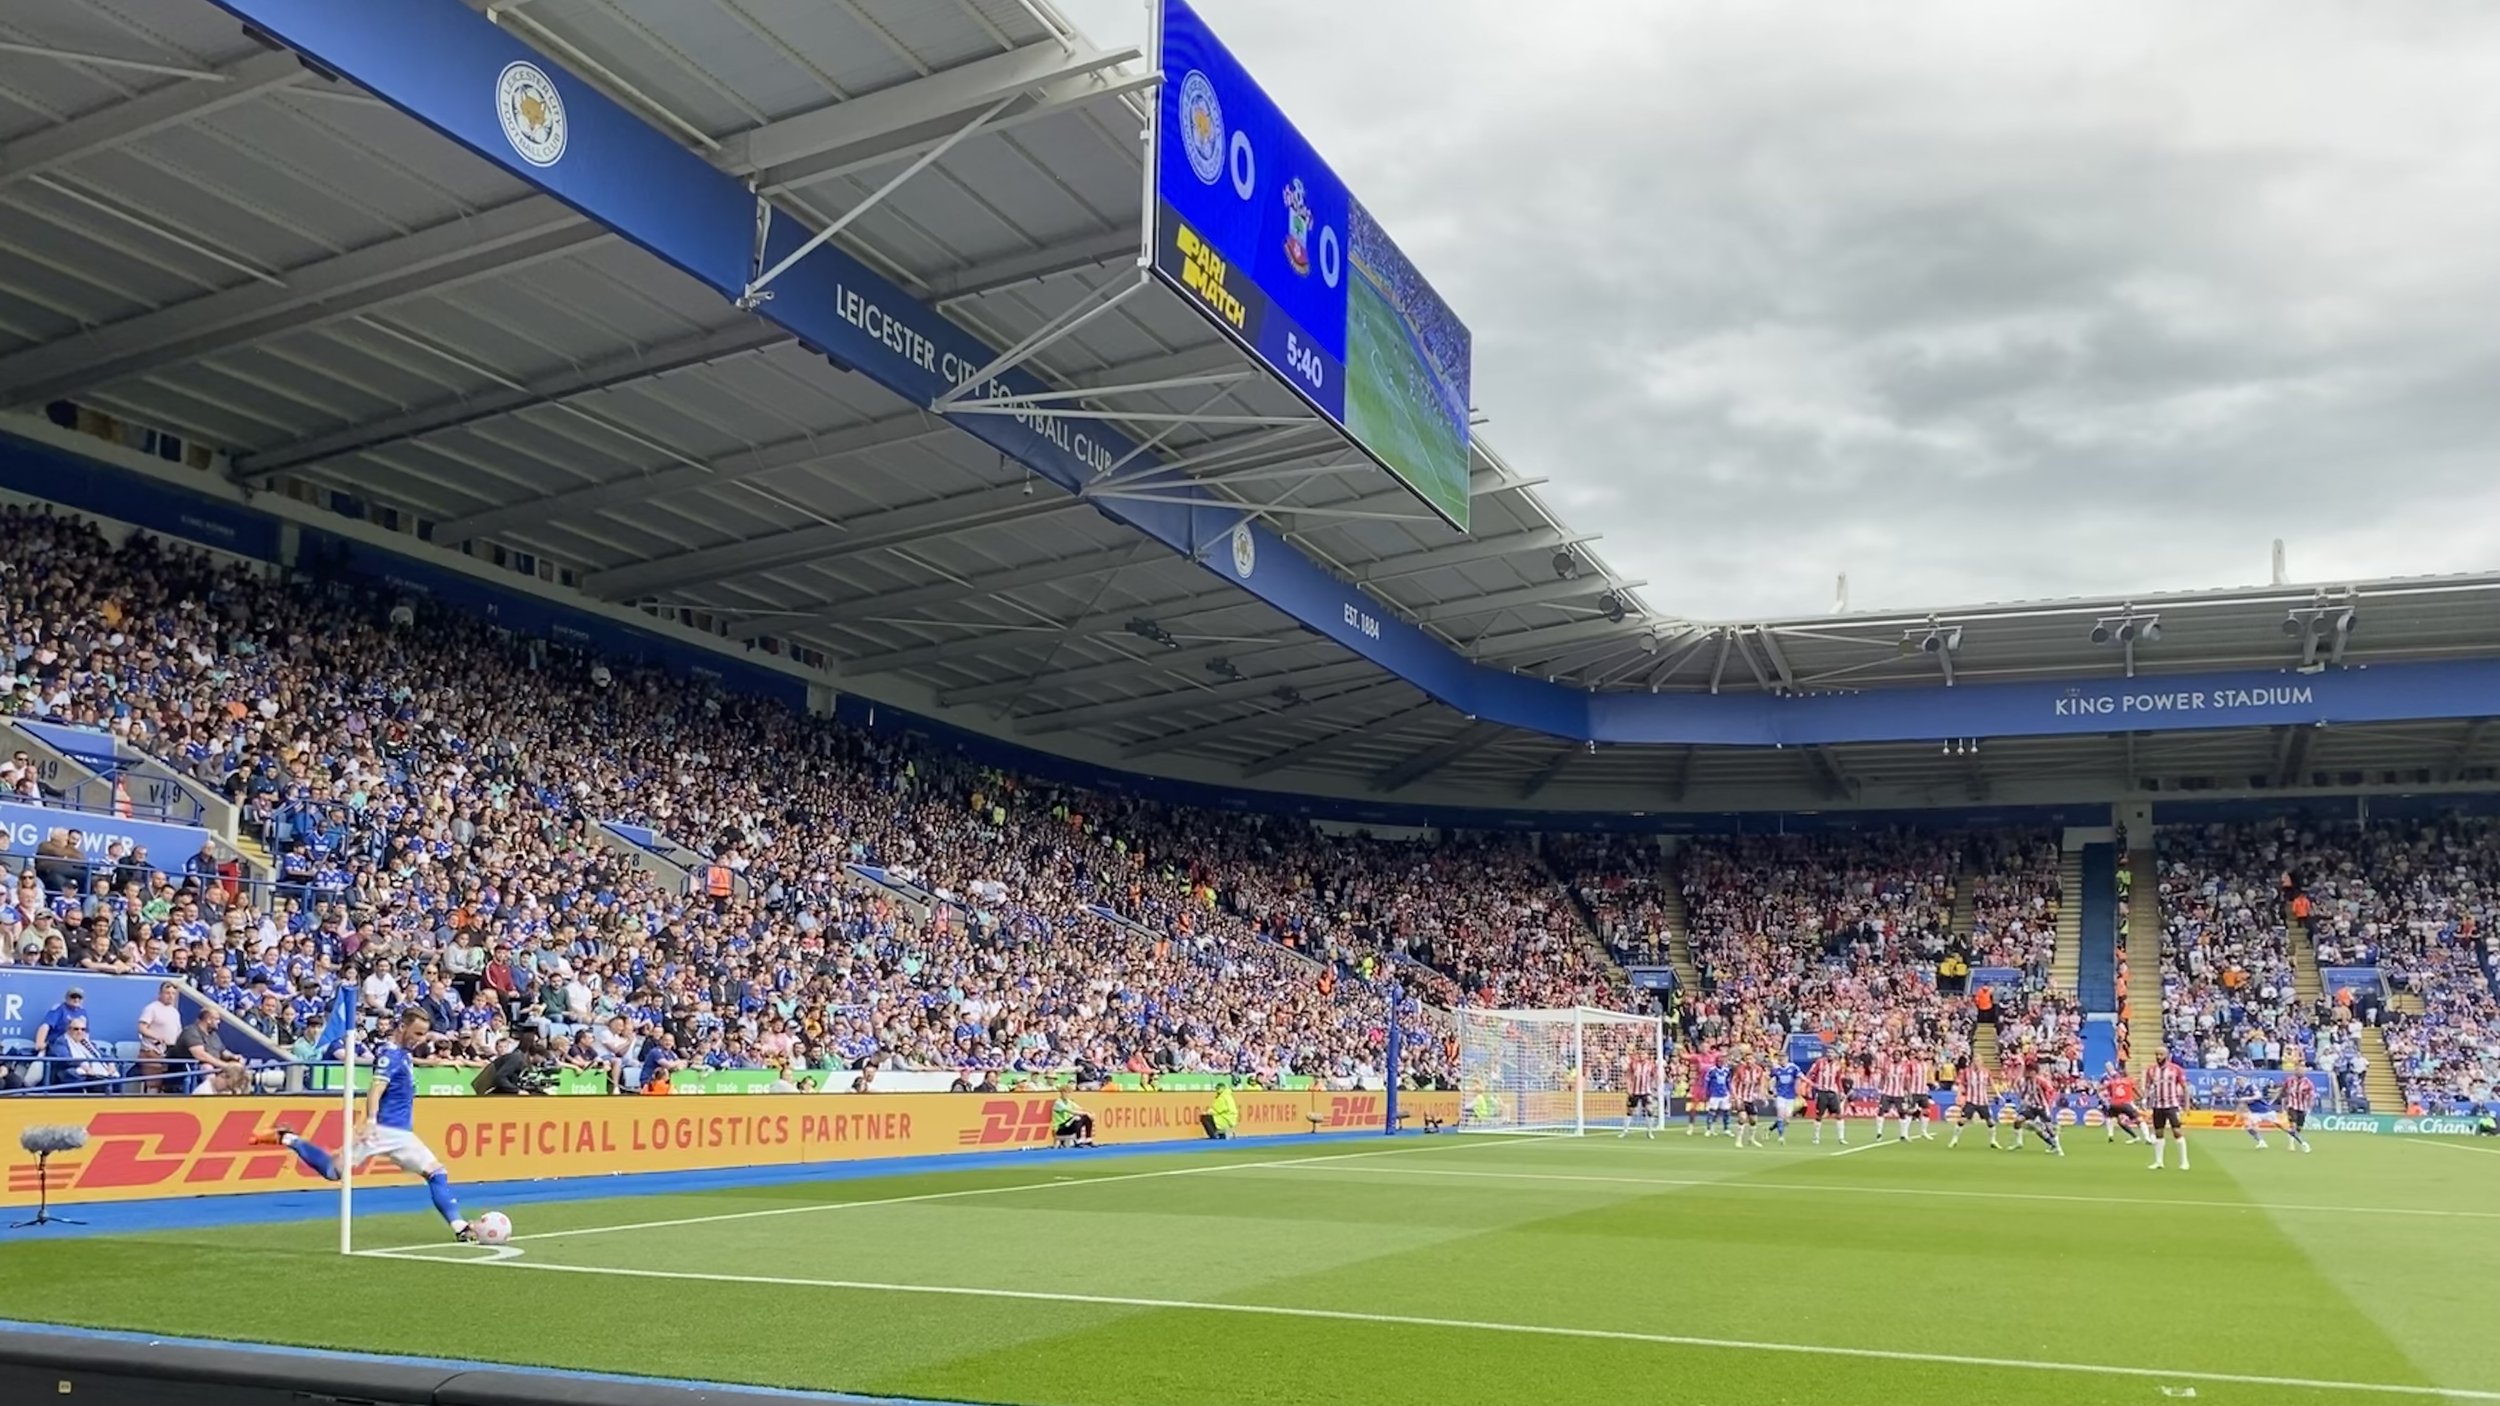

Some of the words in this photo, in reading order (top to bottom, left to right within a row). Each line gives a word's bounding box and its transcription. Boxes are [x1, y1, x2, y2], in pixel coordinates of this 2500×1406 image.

[504, 70, 549, 95] LEICESTER
[1230, 129, 1255, 200] 0
[1176, 222, 1227, 286] PARI
[1319, 224, 1340, 289] 0
[1182, 256, 1246, 330] MATCH
[836, 284, 935, 373] LEICESTER
[1074, 433, 1113, 476] CLUB
[1287, 330, 1323, 389] 5:40
[1344, 602, 1360, 629] EST.
[1361, 612, 1380, 640] 1884
[2055, 698, 2115, 716] KING
[2123, 692, 2205, 713] POWER
[2213, 686, 2313, 708] STADIUM
[979, 1100, 1053, 1144] DH
[1104, 1105, 1170, 1129] OFFICIAL
[1248, 1104, 1297, 1124] PARTNER
[1331, 1096, 1378, 1126] DHL
[2323, 1115, 2379, 1134] Chang
[445, 1121, 616, 1159] OFFICIAL
[632, 1115, 789, 1150] LOGISTICS
[801, 1112, 911, 1142] PARTNER
